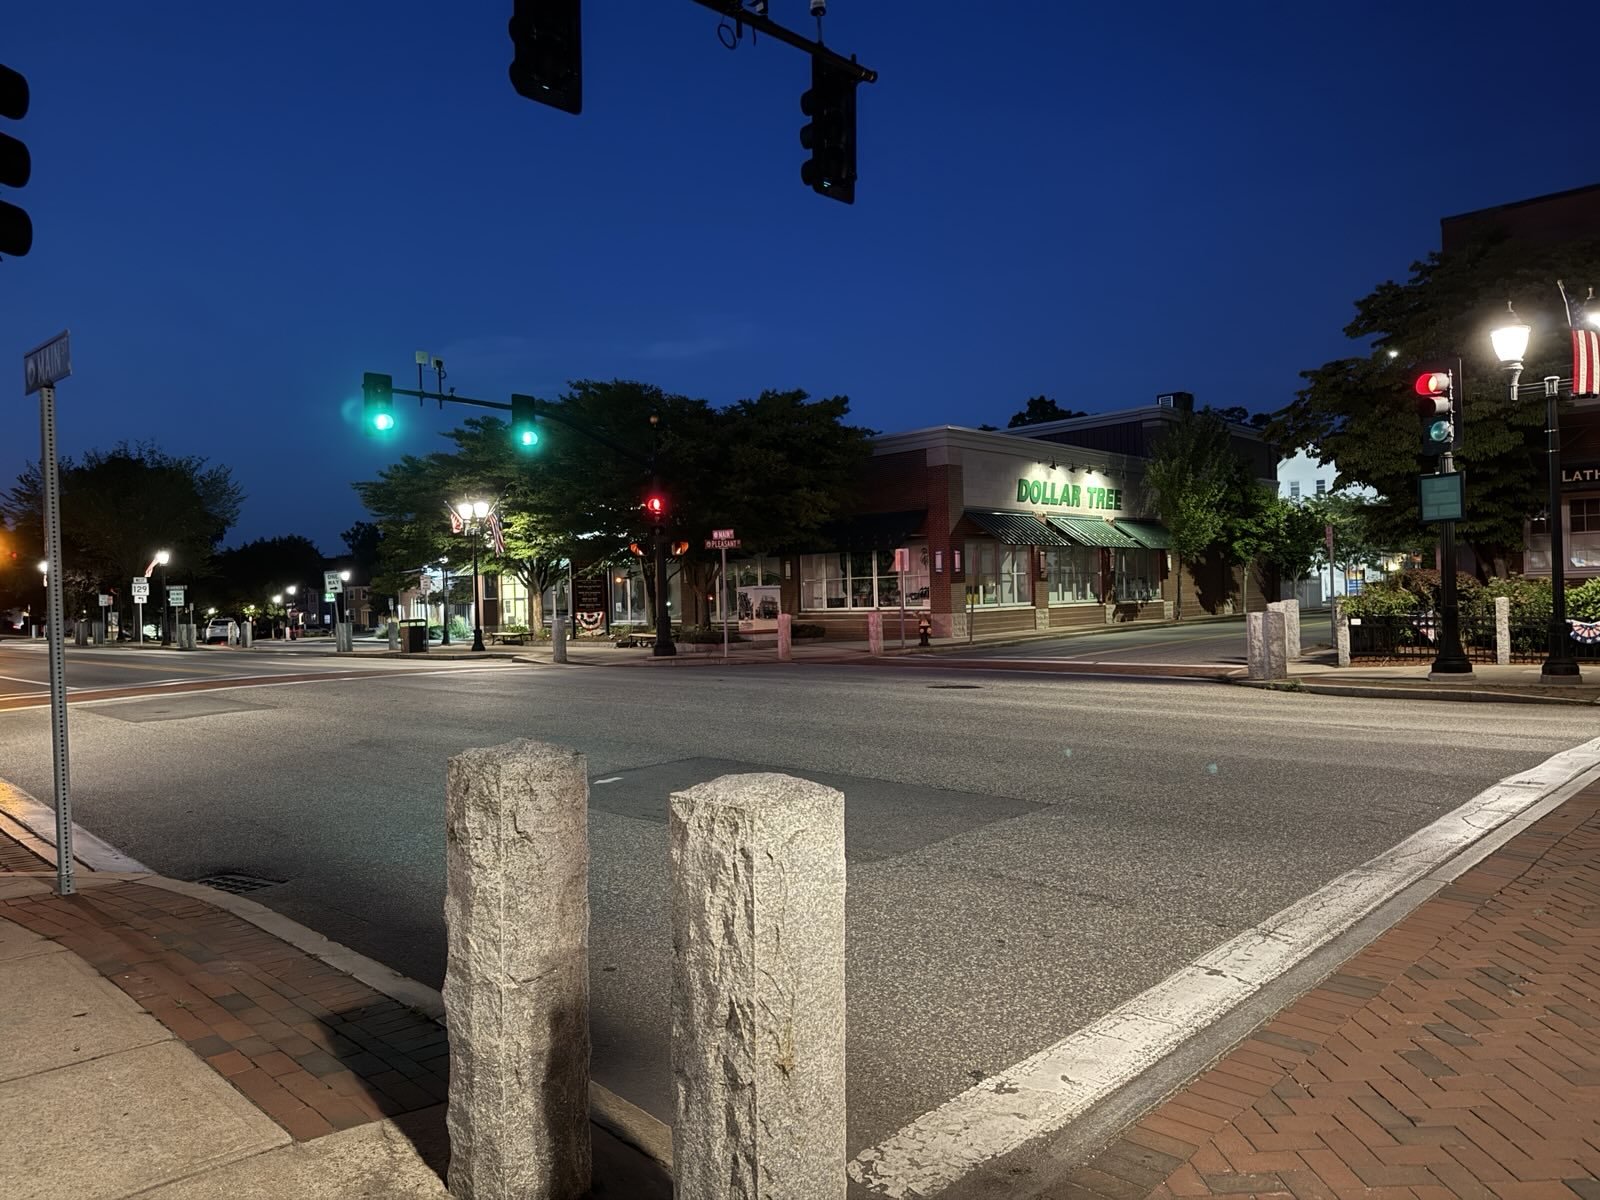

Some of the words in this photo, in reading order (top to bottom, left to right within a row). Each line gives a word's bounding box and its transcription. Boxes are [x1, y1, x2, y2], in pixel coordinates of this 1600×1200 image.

[37, 343, 61, 383] MAIN
[1017, 478, 1081, 508] DOLLAR
[1087, 486, 1122, 510] TREE
[712, 540, 737, 548] PLEASANT
[133, 585, 147, 593] 129
